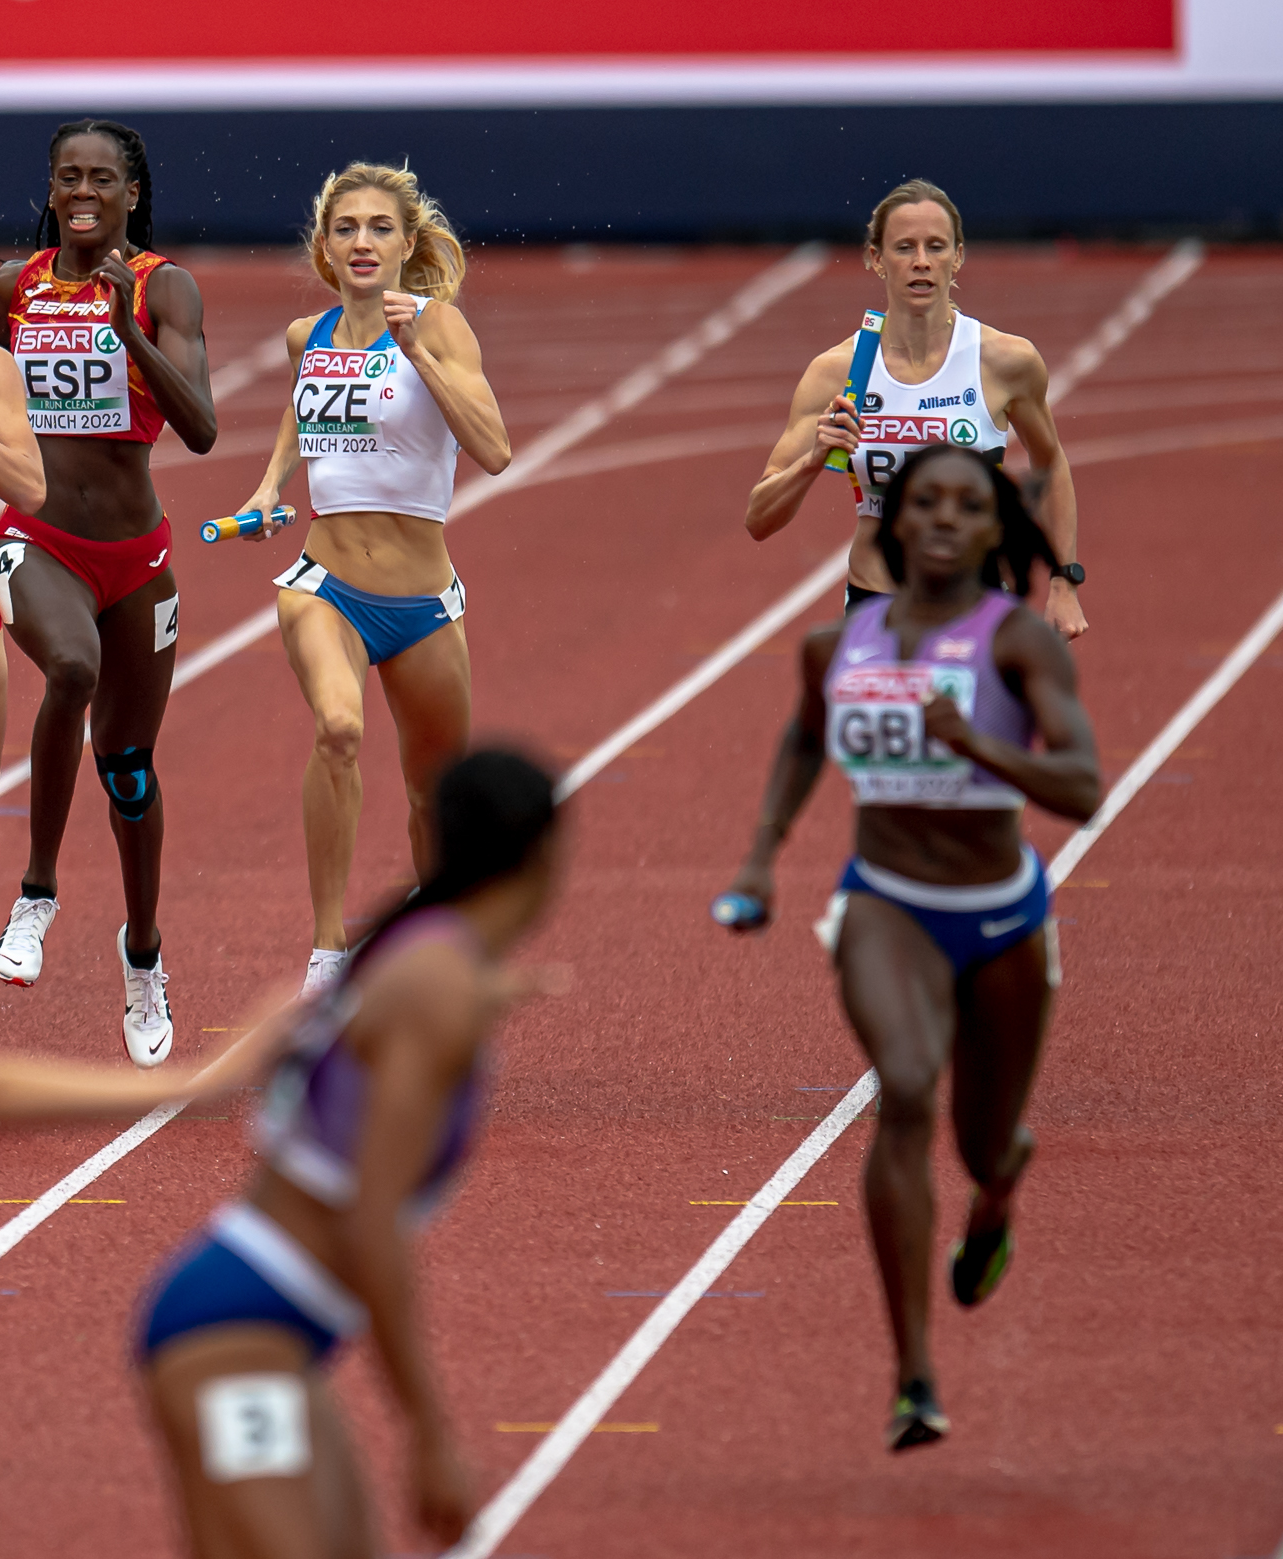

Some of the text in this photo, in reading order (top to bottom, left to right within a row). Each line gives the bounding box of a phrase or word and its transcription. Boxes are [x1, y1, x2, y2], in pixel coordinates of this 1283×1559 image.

[19, 329, 90, 350] SPAR
[302, 353, 364, 376] SPAR
[24, 359, 113, 400] ESP
[45, 400, 62, 410] RUN
[296, 383, 372, 423] CZE
[918, 394, 961, 411] Allianz
[27, 412, 122, 430] MUNICH 2022
[305, 424, 325, 433] RUN
[860, 419, 945, 441] SPAR
[342, 437, 378, 453] 2022
[286, 551, 317, 587] 7
[165, 601, 179, 636] 4
[838, 708, 945, 758] GB
